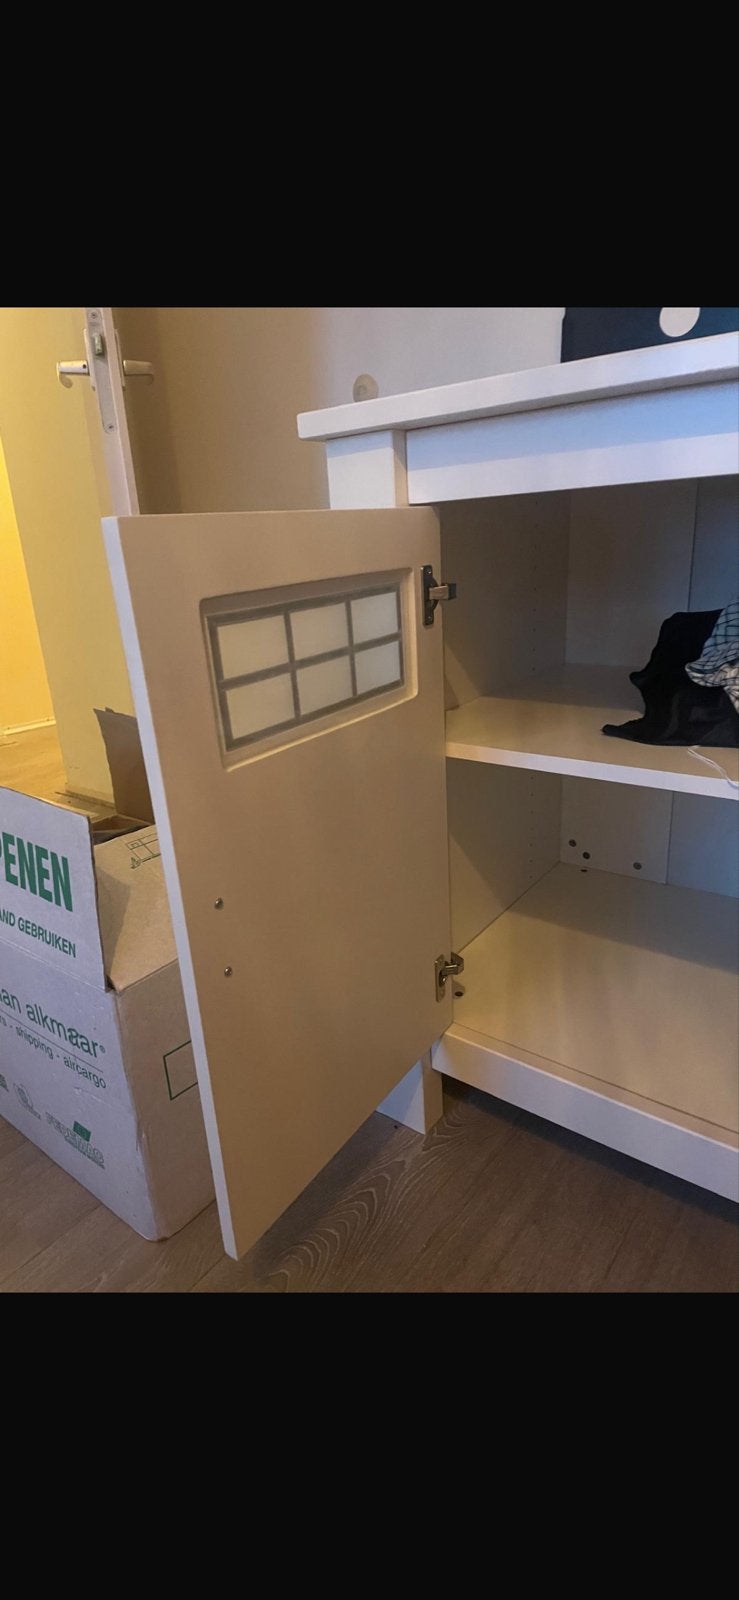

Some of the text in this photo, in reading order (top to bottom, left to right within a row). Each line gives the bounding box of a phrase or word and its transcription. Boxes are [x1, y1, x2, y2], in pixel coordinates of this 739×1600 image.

[0, 831, 73, 912] ENEN
[18, 916, 76, 958] GEBRUIKEN
[0, 988, 21, 1014] an
[63, 1056, 107, 1089] aircargo
